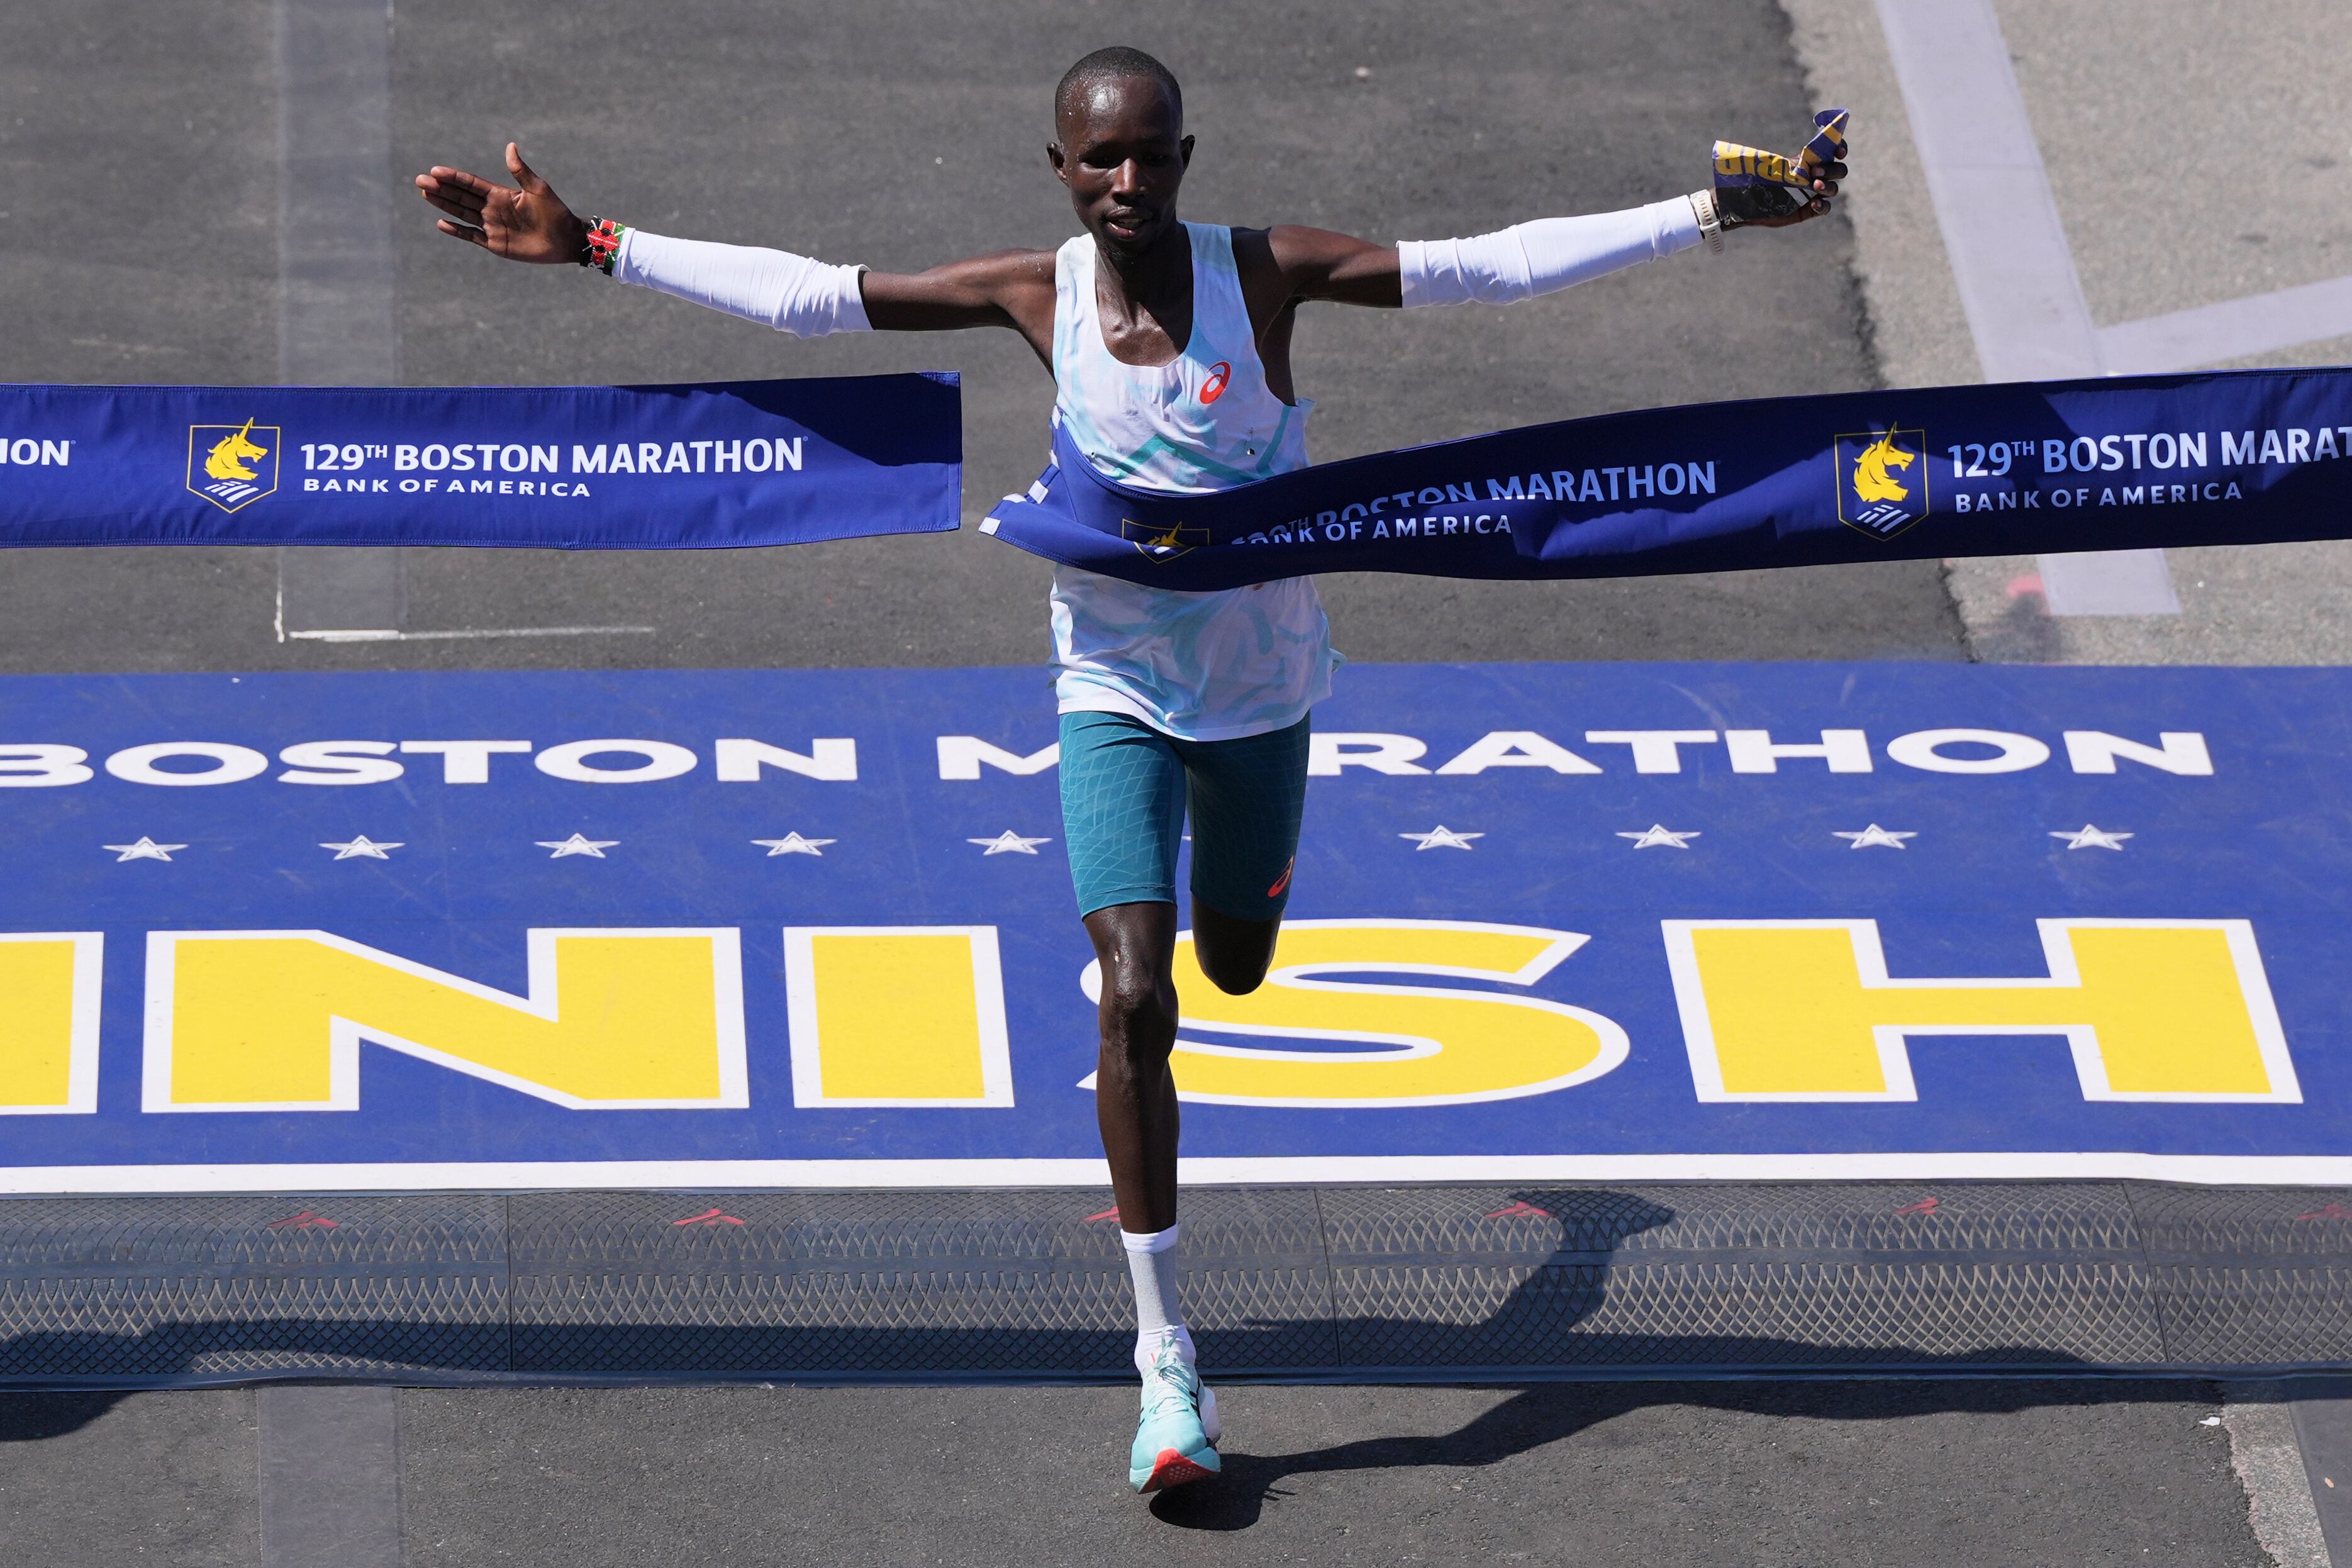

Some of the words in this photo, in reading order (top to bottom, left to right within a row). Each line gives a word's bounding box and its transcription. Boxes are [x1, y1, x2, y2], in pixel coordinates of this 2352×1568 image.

[301, 443, 387, 470] 129TH
[394, 443, 559, 474] BOSTON
[572, 437, 803, 474] MARATHON
[1948, 440, 2035, 478] 129TH
[2043, 431, 2207, 473] BOSTON
[304, 479, 389, 492] BANK
[399, 479, 438, 492] OF
[447, 479, 590, 497] AMERICA
[1486, 460, 1716, 502] MARATHON
[1955, 491, 2041, 513] BANK
[2051, 488, 2088, 508] OF
[2099, 482, 2243, 506] AMERICA
[1325, 520, 1363, 542] OF
[1372, 514, 1512, 539] AMERICA
[937, 728, 2214, 781] MRATHON
